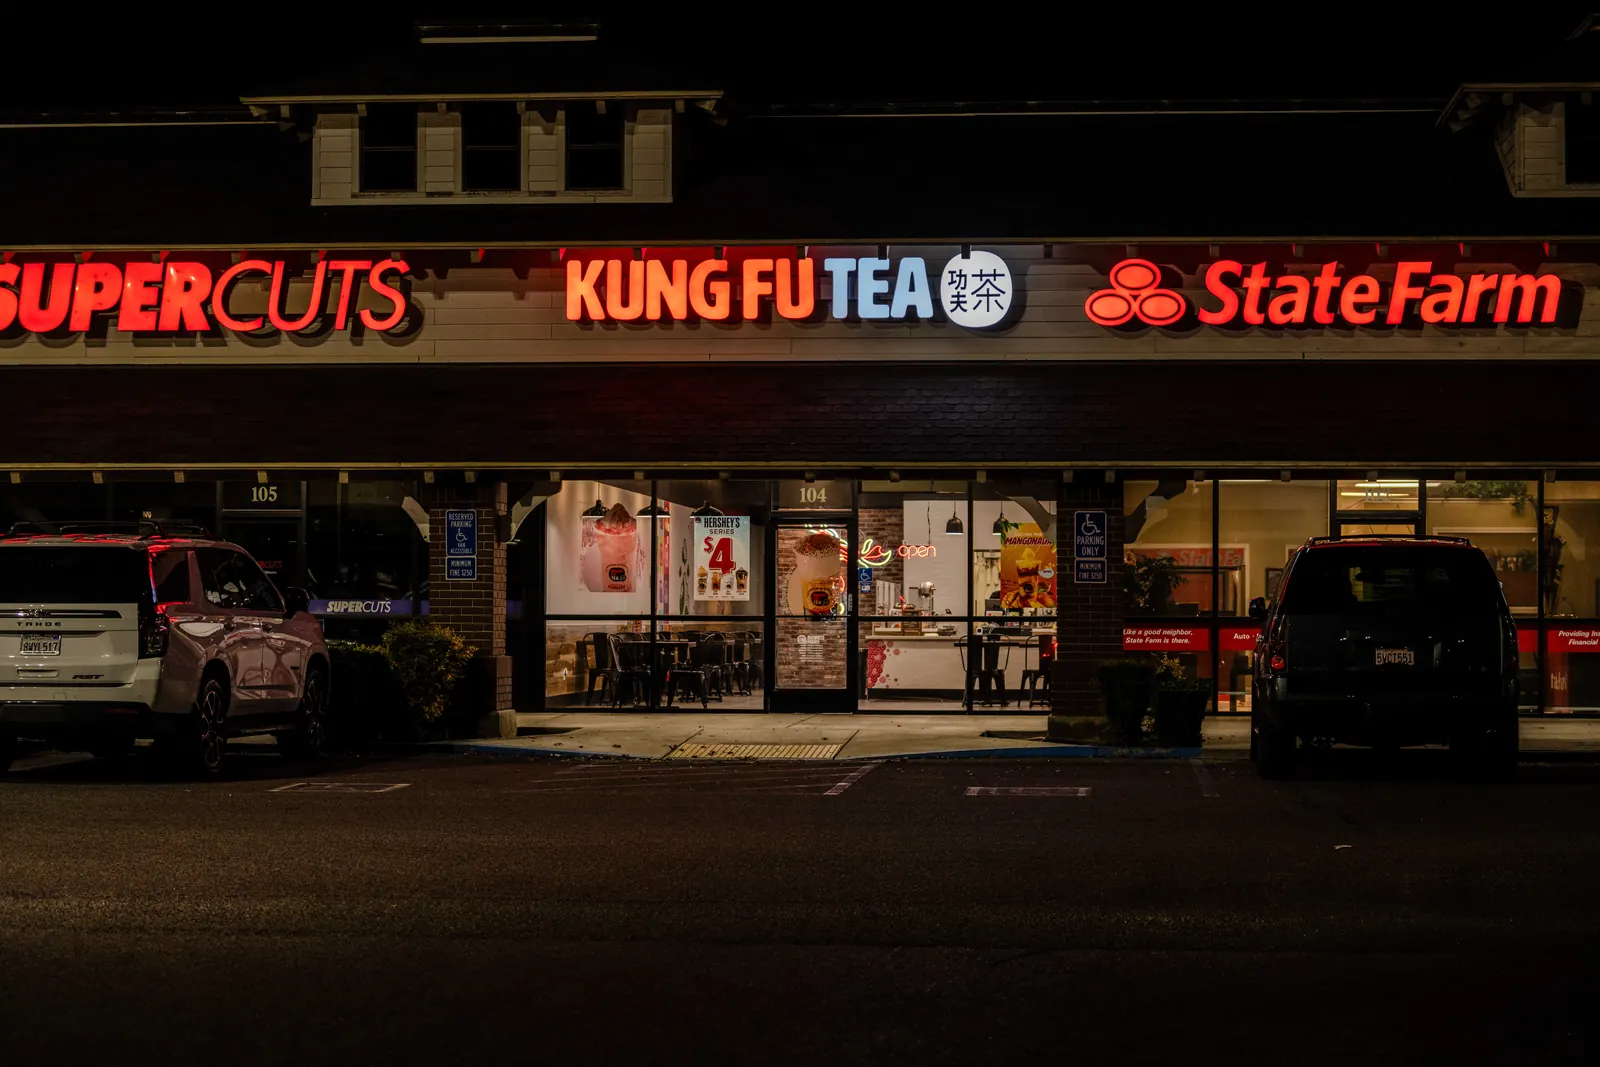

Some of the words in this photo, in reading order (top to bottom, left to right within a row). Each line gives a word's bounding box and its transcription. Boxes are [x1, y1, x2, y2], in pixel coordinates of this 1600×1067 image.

[565, 258, 729, 321] KUNG
[742, 257, 815, 320] FU
[824, 256, 934, 319] TEA
[948, 269, 968, 314] 功夫
[970, 268, 1006, 313] 茶
[251, 486, 278, 502] 105
[799, 487, 828, 503] 104
[448, 513, 474, 521] RESERVED
[703, 517, 741, 528] HERSHEY'S
[1076, 536, 1105, 545] PARKING
[703, 536, 736, 576] $4
[898, 545, 936, 560] open
[1081, 546, 1100, 556] ONLY
[449, 569, 460, 577] FINE
[461, 569, 473, 577] $250
[1078, 571, 1090, 580] FINE
[1091, 571, 1103, 580] $250
[326, 600, 392, 613] SUPERCUTS
[1144, 628, 1161, 636] good
[1162, 628, 1193, 636] neighbor,
[1558, 630, 1590, 638] Providing
[23, 642, 58, 652] 8WYL517
